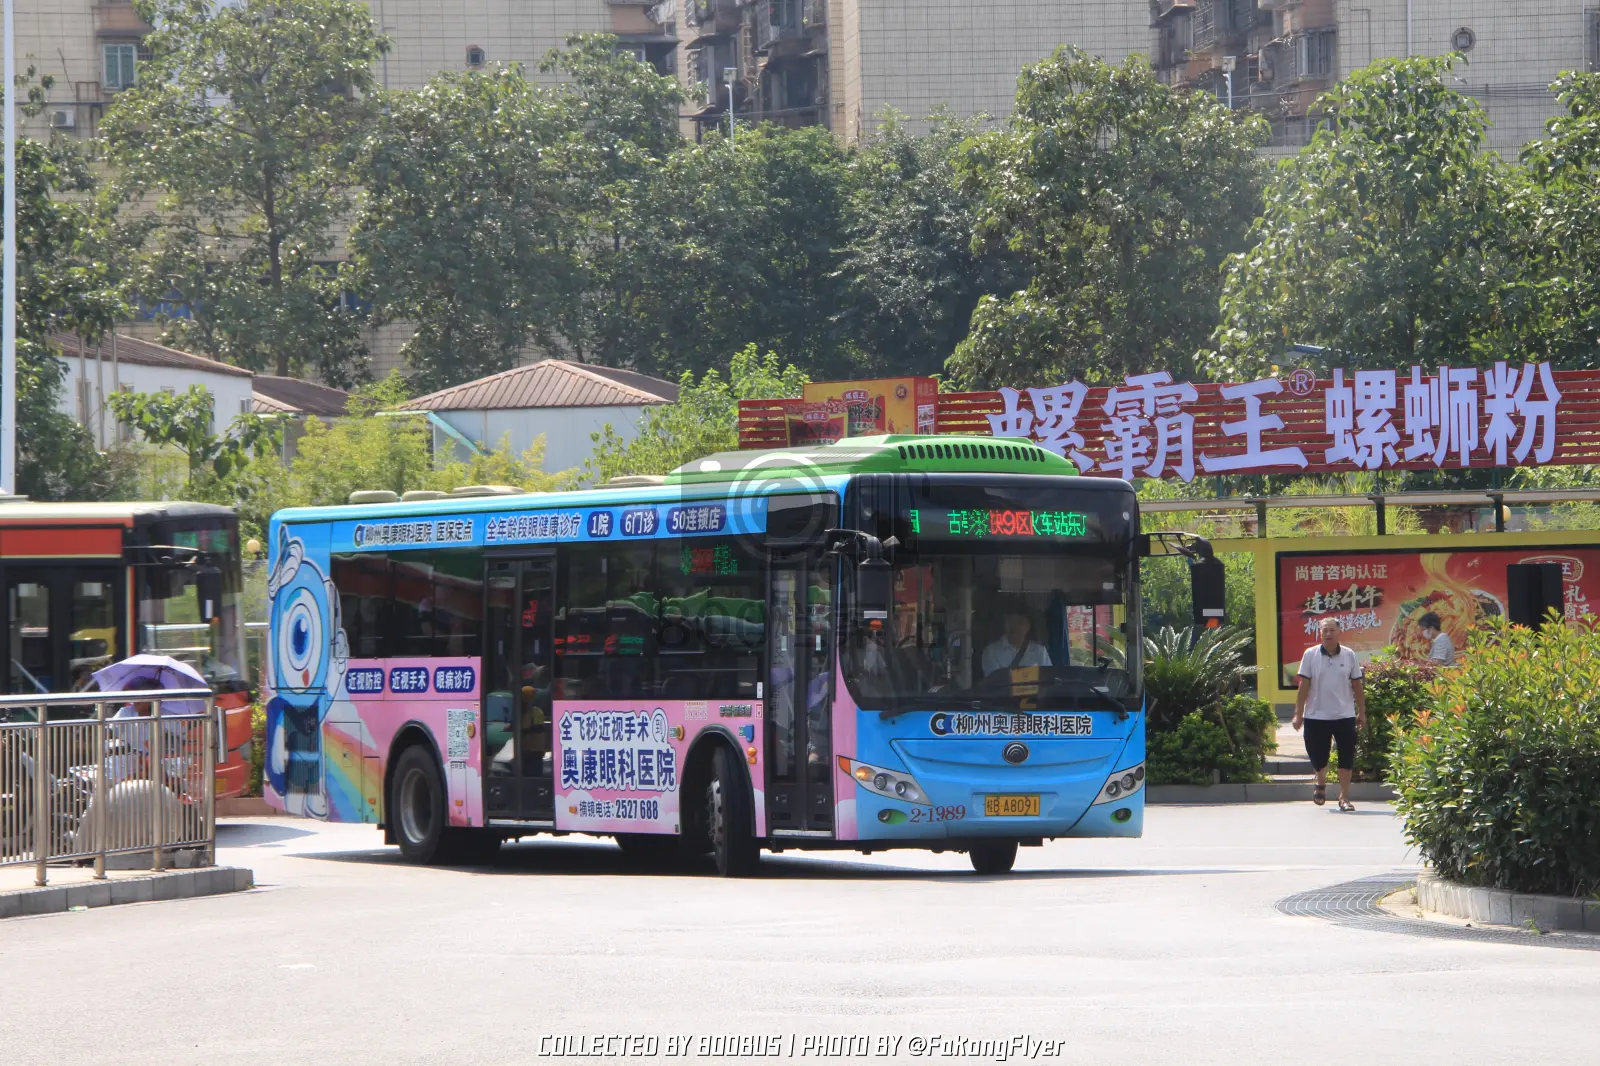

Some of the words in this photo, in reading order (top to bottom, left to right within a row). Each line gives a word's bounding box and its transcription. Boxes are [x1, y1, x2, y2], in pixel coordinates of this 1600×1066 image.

[985, 371, 1309, 483] 螺霸王
[1325, 360, 1562, 470] 螺蛳粉
[436, 519, 473, 542] 医保定点
[486, 512, 582, 541] 全年龄段眼健康诊疗
[591, 513, 610, 535] 1院
[625, 511, 655, 535] 6门诊
[672, 507, 721, 531] 50连锁店
[1295, 563, 1388, 581] 尚普咨询认证
[1302, 583, 1384, 614] 连续4年
[348, 671, 382, 690] 近视防控
[391, 670, 427, 690] 近视手术
[436, 670, 472, 690] 眼病诊疗
[561, 715, 649, 742] 全飞秒近视手术
[956, 713, 1092, 736] 柳州奥康眼科医院
[562, 747, 675, 787] 奥康眼科医院
[909, 805, 966, 823] 2-1989
